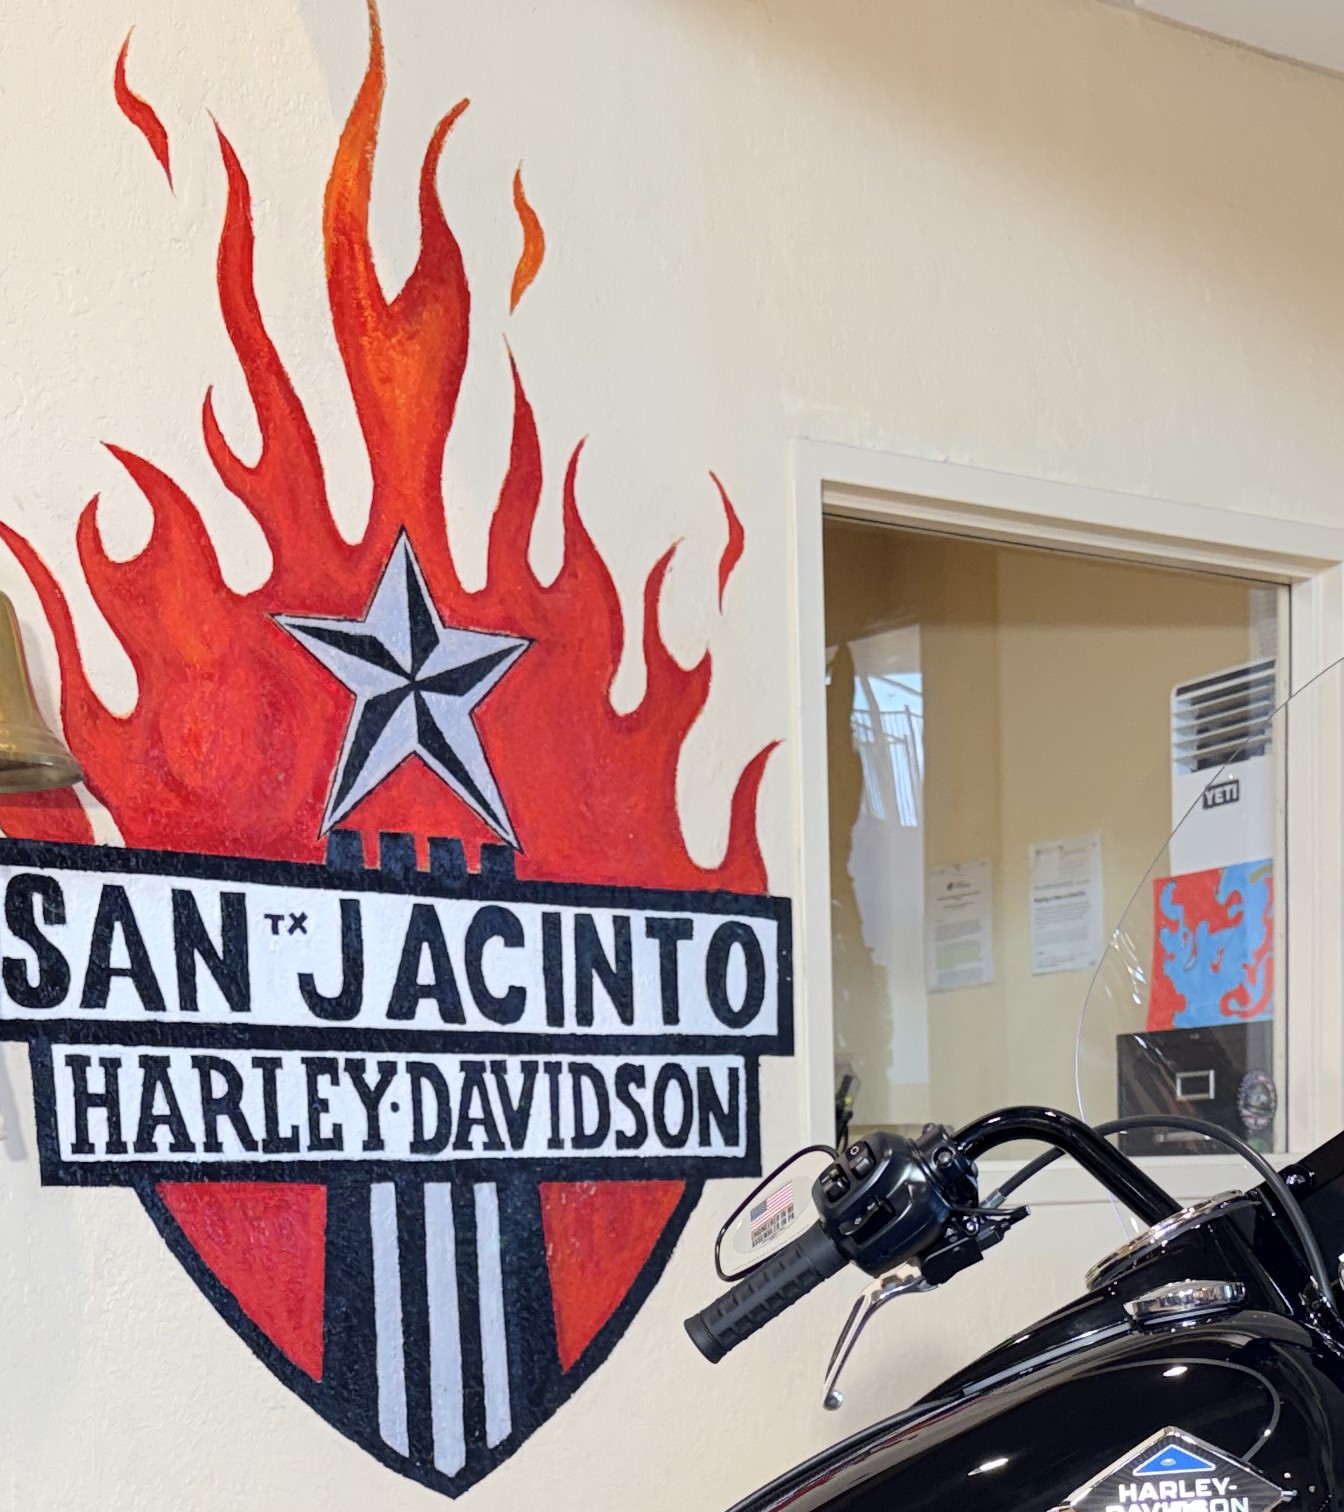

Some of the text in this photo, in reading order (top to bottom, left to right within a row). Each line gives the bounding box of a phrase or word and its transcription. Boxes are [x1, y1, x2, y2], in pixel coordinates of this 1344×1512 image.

[1204, 783, 1238, 806] YETI
[2, 872, 766, 1029] SAN TX JACINTO
[1118, 1477, 1238, 1503] HARLEY-
